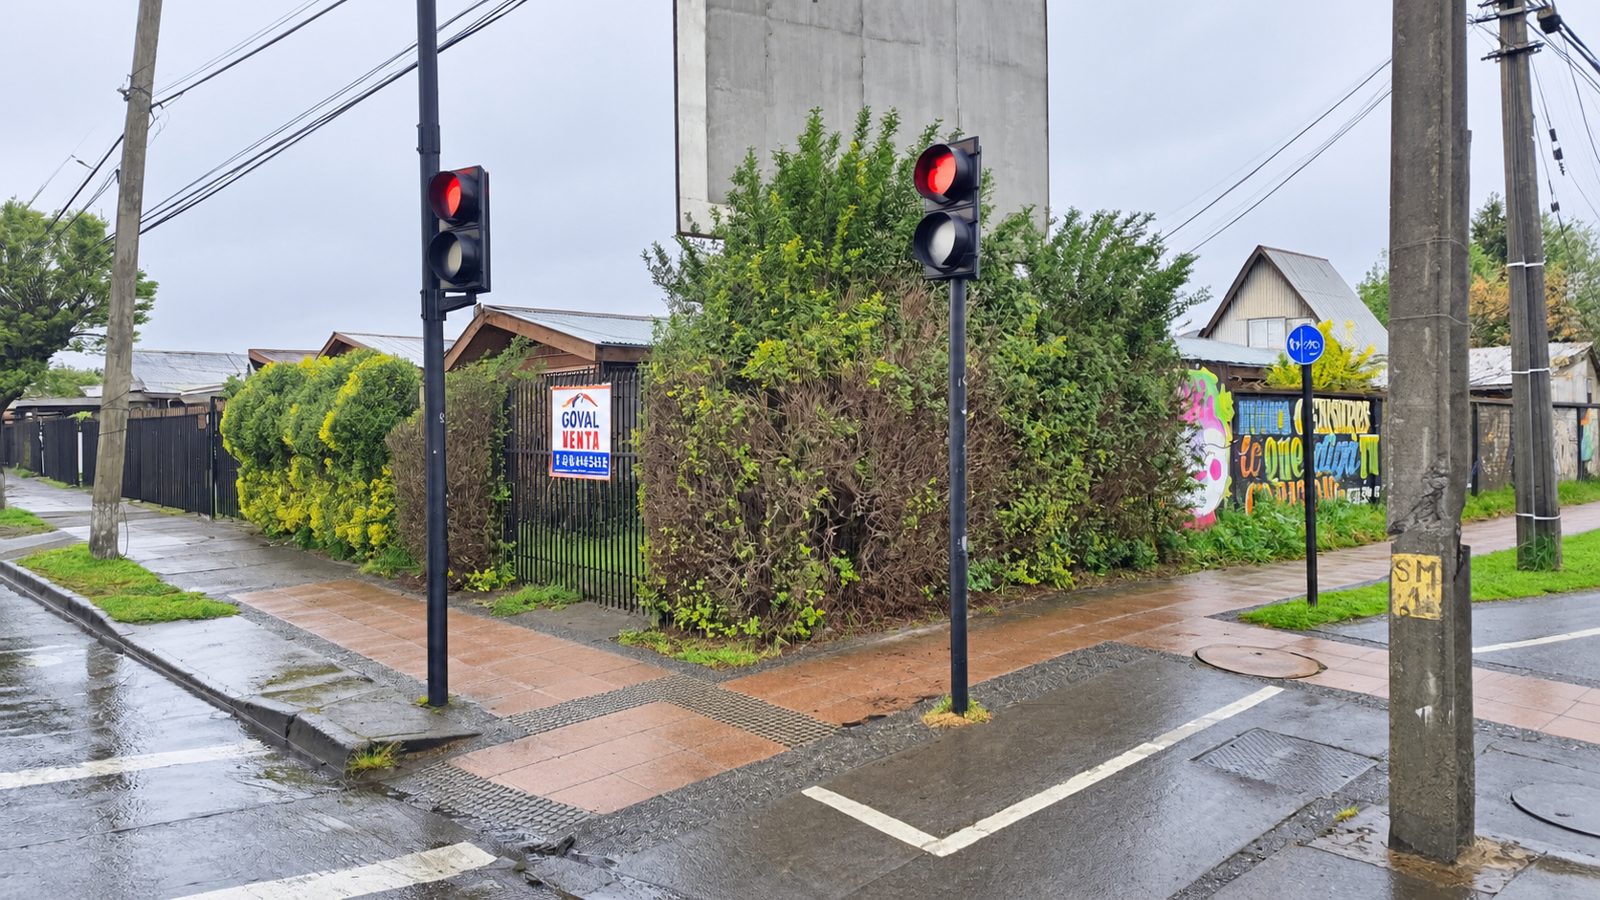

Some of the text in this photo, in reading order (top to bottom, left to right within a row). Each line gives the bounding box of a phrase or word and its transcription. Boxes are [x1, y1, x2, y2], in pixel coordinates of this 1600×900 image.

[562, 411, 599, 428] GOVAL
[562, 430, 600, 450] VENTA
[1393, 559, 1437, 590] SM
